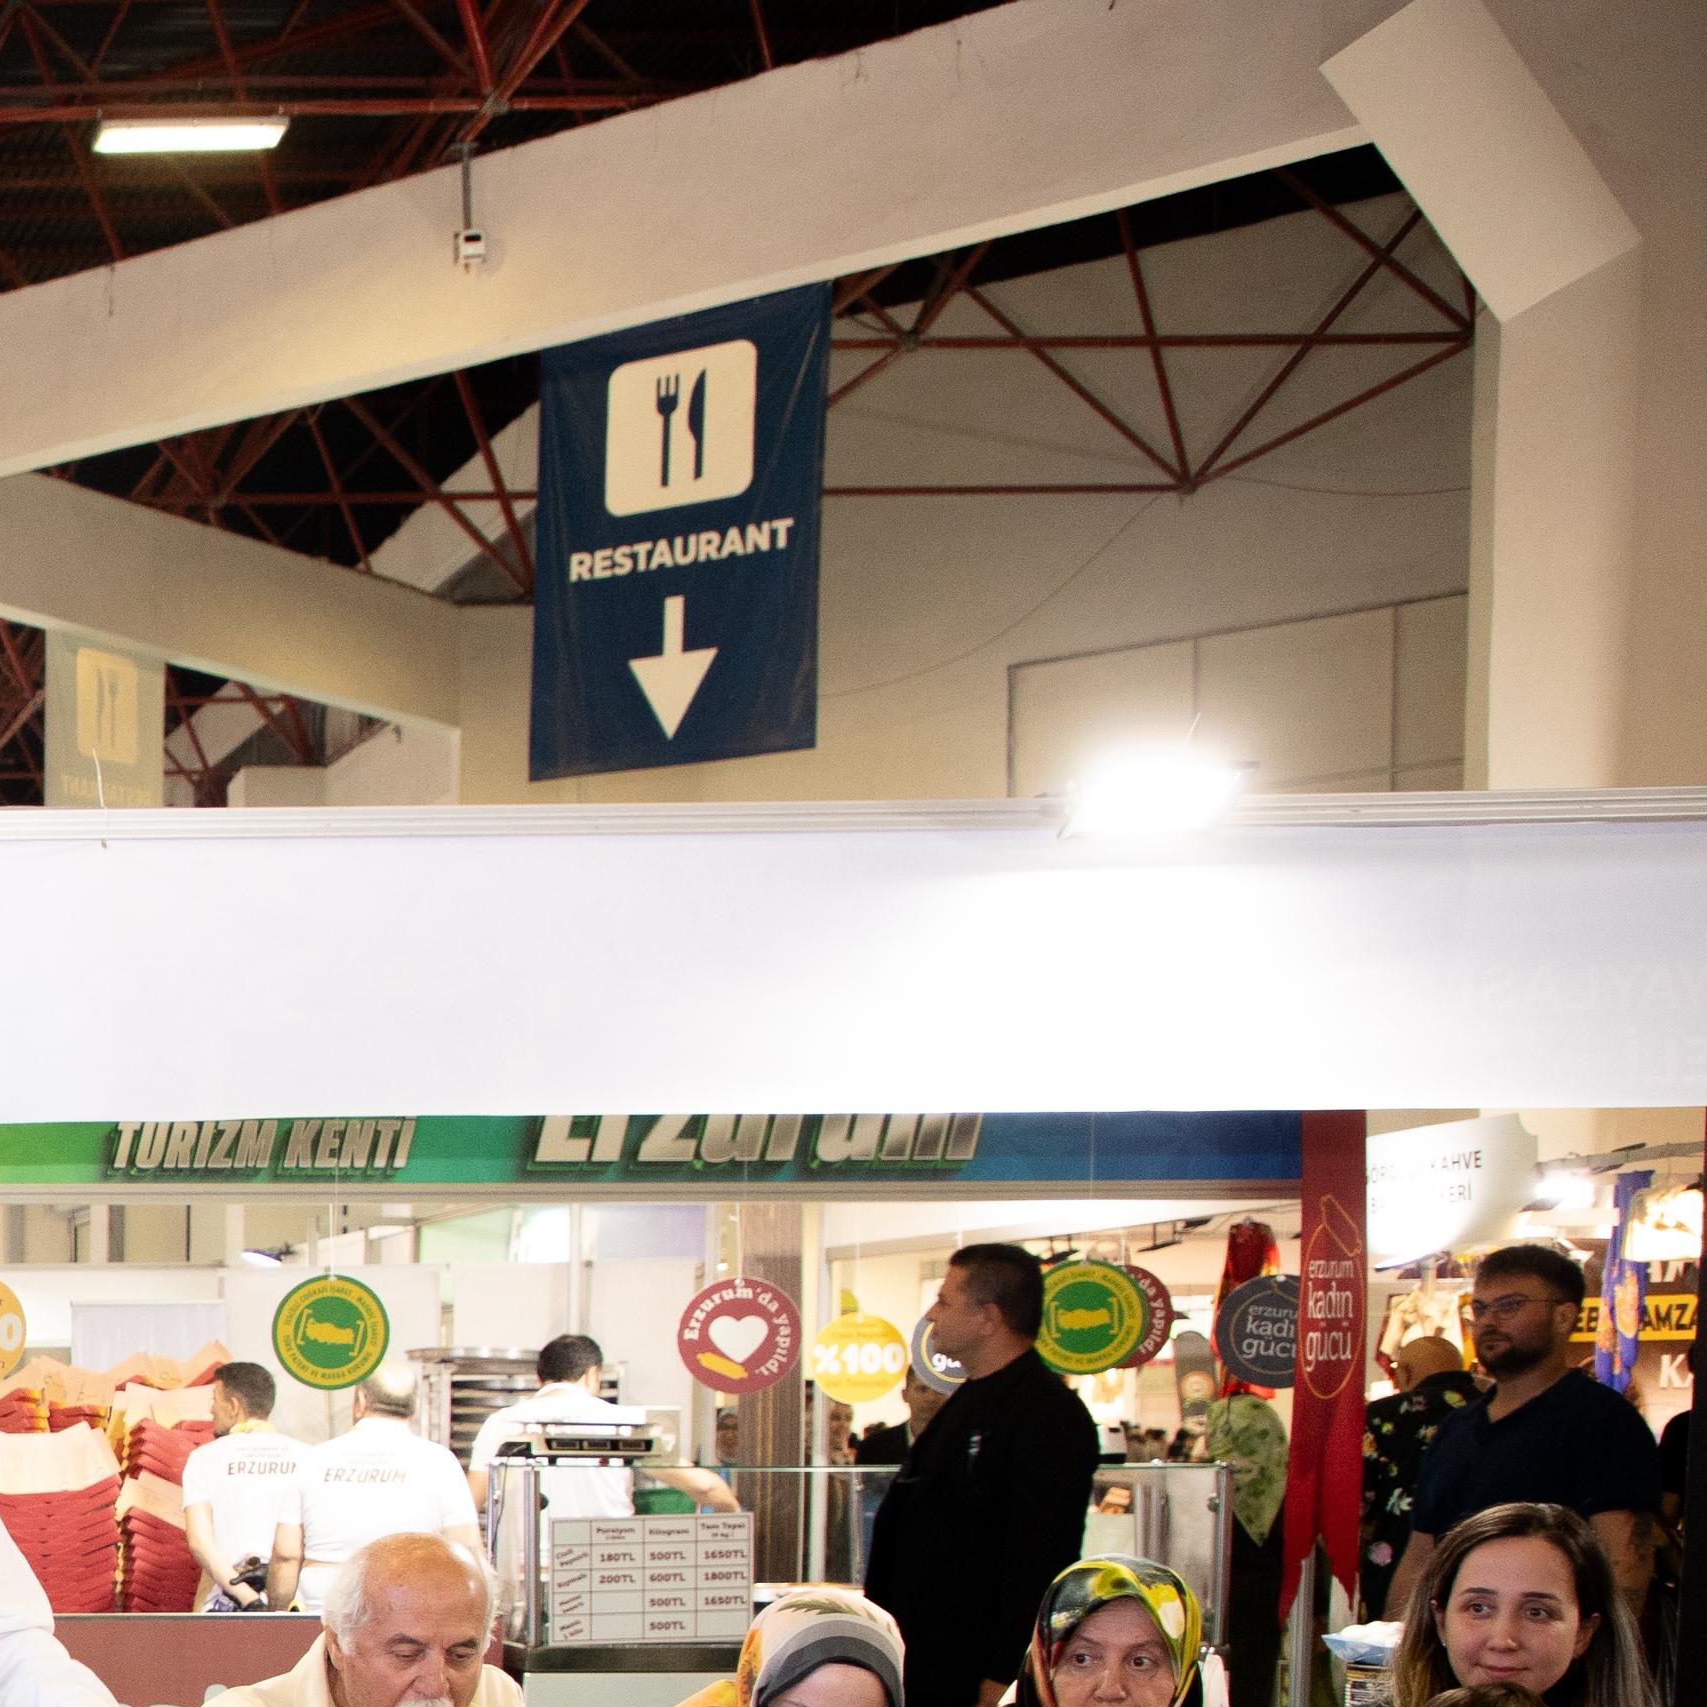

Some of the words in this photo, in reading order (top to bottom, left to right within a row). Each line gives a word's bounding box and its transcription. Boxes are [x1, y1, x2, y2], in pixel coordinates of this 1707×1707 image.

[568, 516, 795, 584] RESTAURANT
[1307, 1260, 1354, 1279] erzurum
[1306, 1281, 1354, 1320] kadın
[1245, 1317, 1295, 1340] kadı
[814, 1342, 904, 1376] %100
[323, 1467, 409, 1484] ERZURUM
[599, 1573, 636, 1585] 200TL
